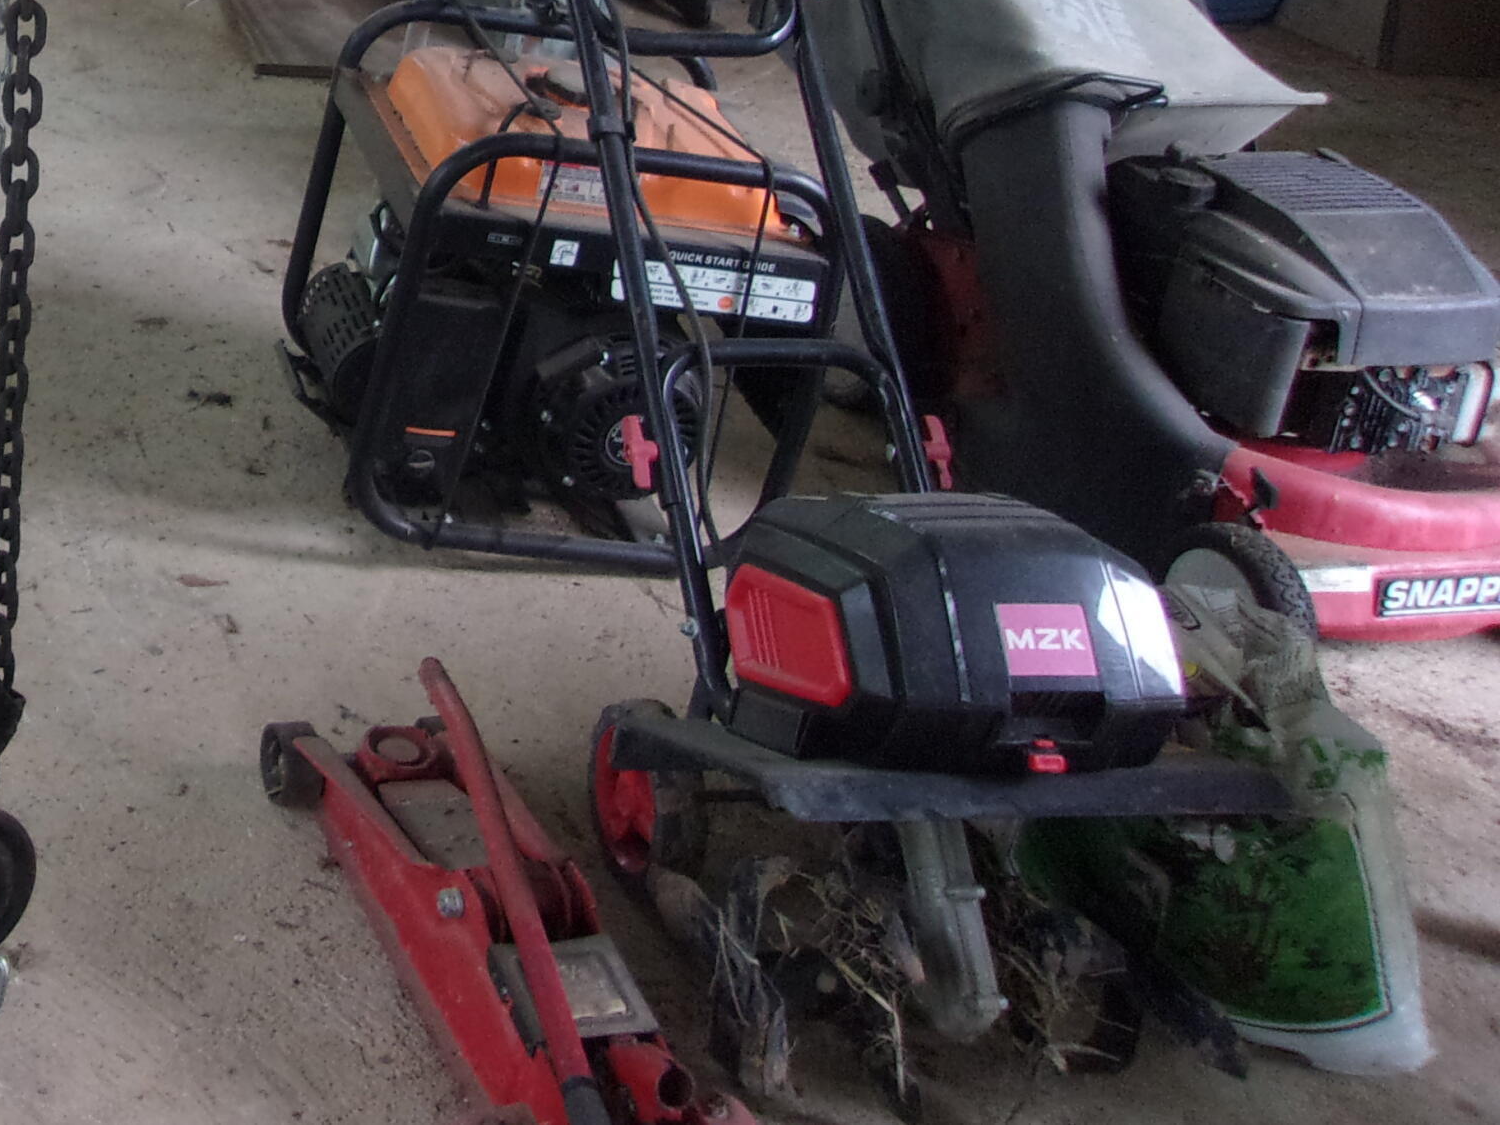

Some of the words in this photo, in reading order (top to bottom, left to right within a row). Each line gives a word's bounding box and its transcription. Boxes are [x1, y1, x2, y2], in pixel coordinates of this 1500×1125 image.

[668, 250, 704, 263] QUICK
[704, 254, 741, 268] START
[742, 260, 776, 273] GIDE
[1383, 576, 1500, 609] SNAPP
[1004, 628, 1086, 650] MZK
